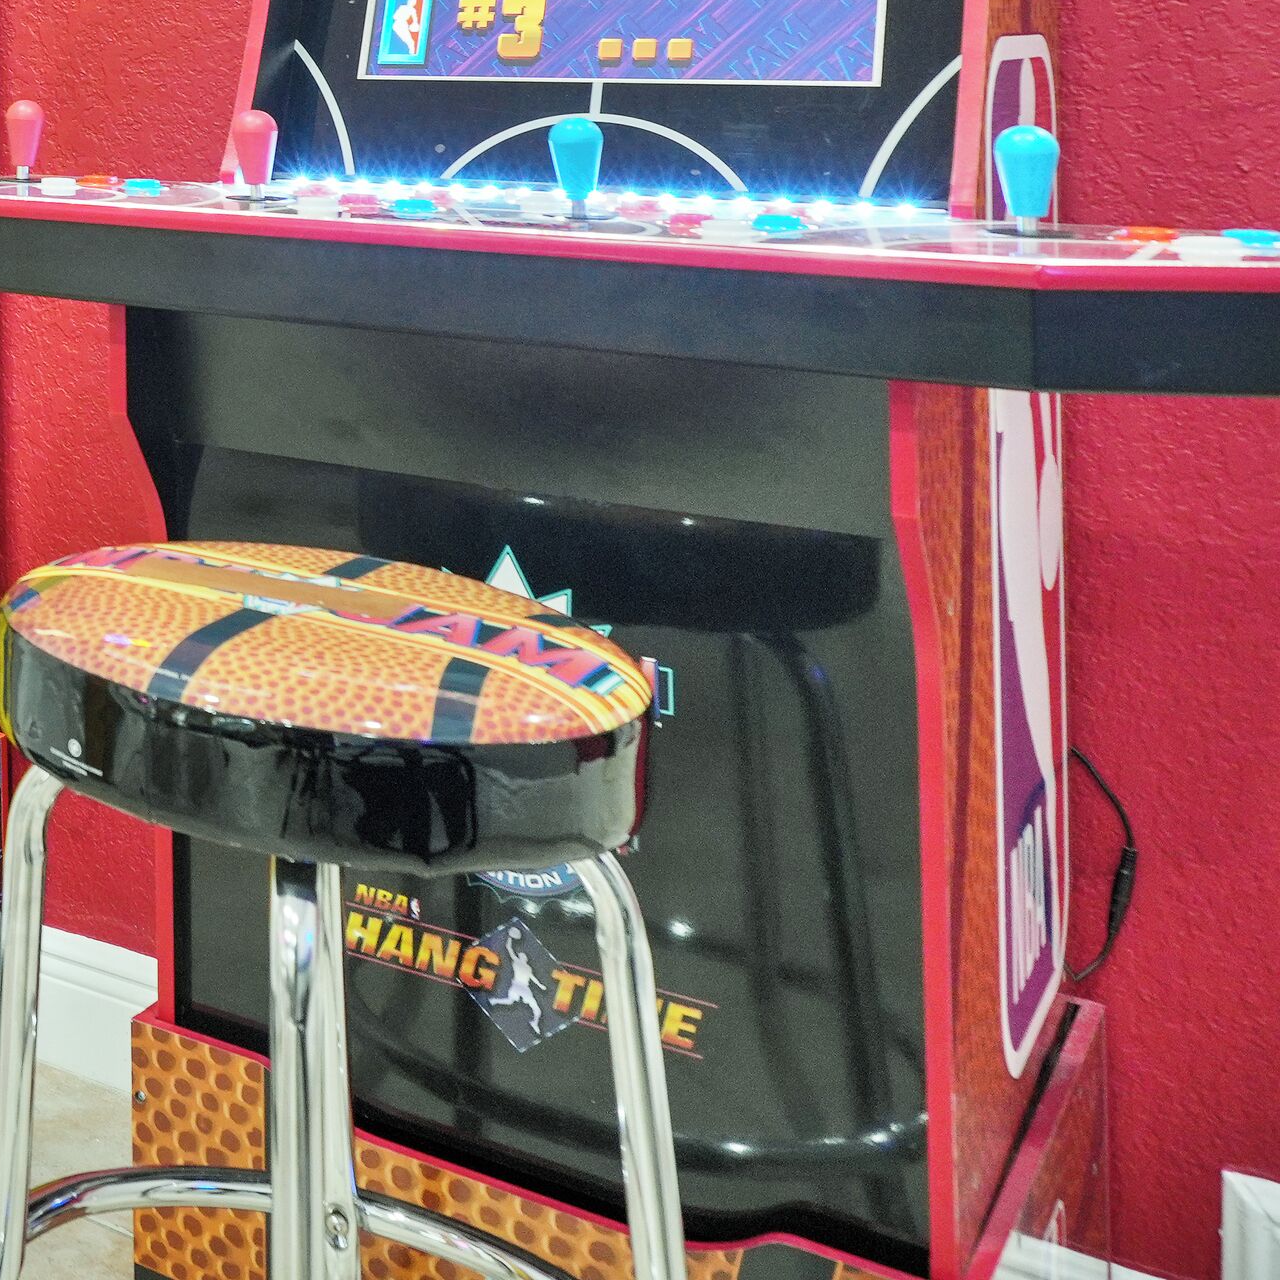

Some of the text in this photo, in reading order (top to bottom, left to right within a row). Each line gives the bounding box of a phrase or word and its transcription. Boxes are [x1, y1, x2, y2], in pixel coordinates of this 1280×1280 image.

[488, 870, 562, 889] ITION
[354, 883, 409, 918] NBA
[345, 911, 704, 1051] HANG TIE
